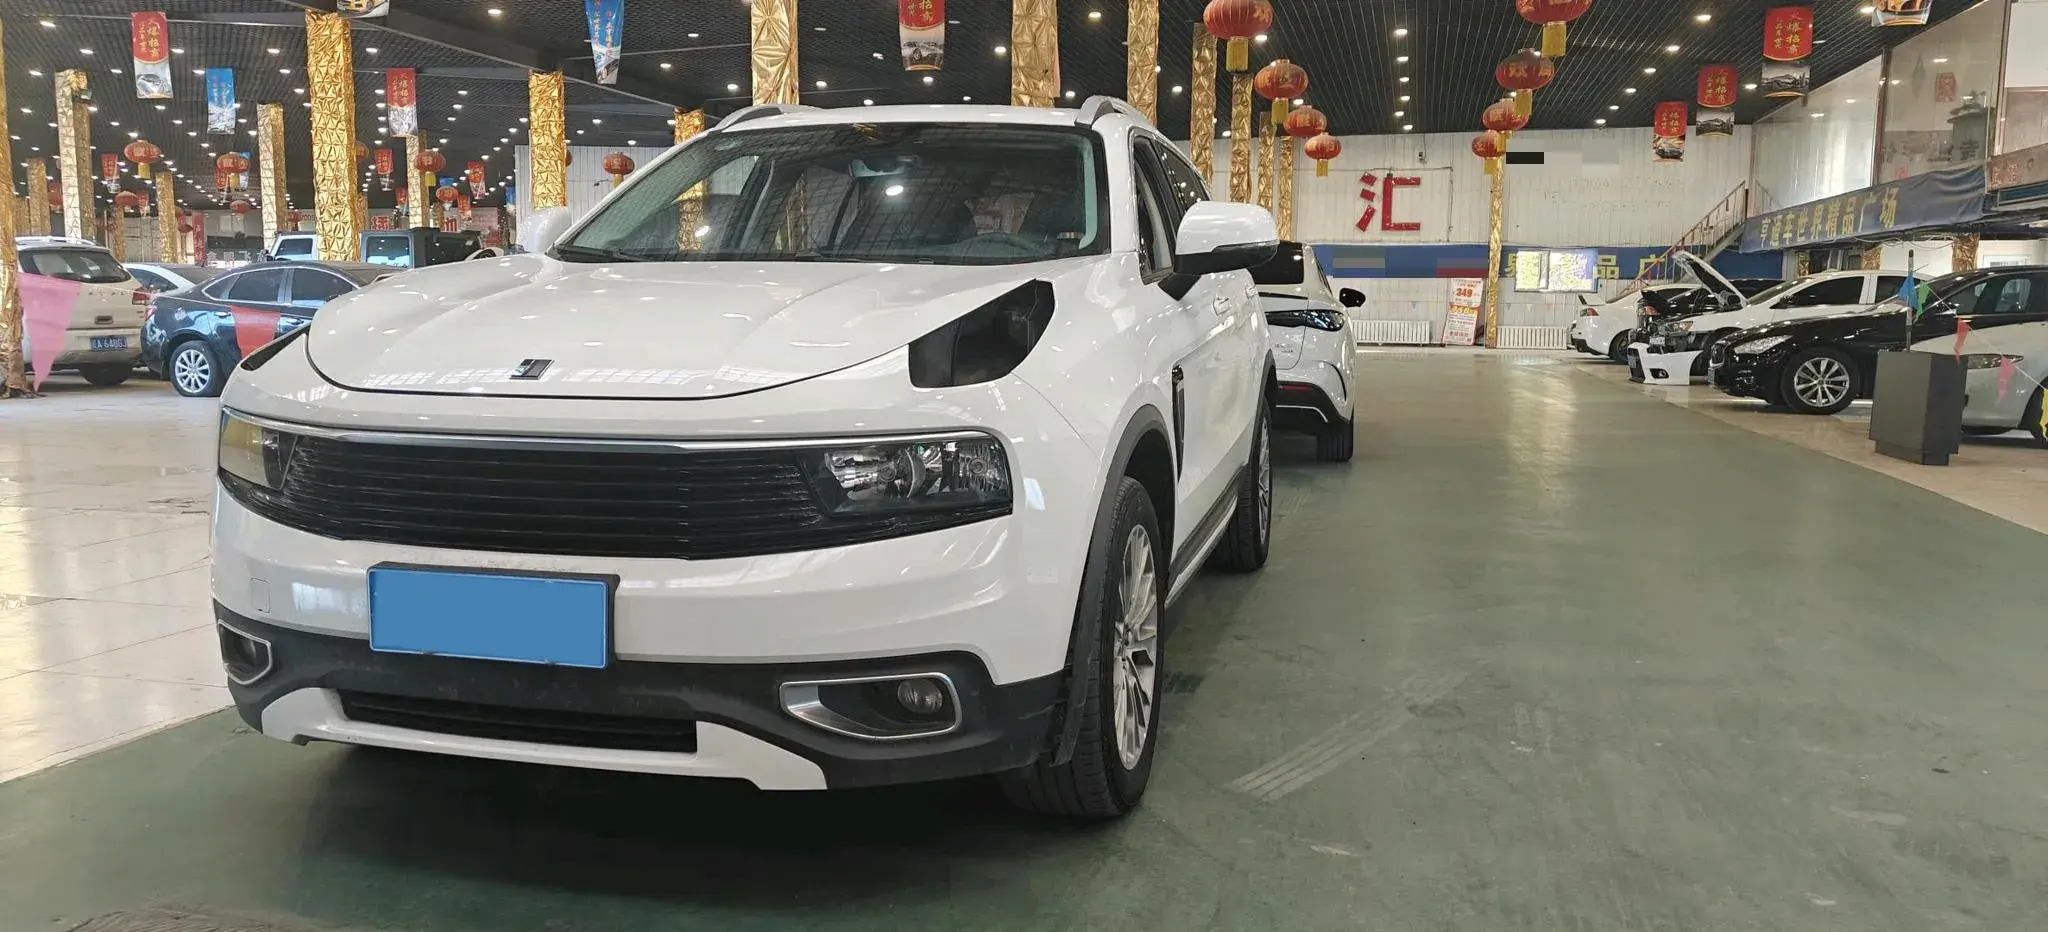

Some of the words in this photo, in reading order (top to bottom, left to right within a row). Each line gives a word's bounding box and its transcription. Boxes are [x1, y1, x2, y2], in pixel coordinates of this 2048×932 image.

[1356, 172, 1421, 232] 汇
[1760, 187, 1899, 248] 亨通车世界精品广场
[1456, 288, 1473, 297] 349
